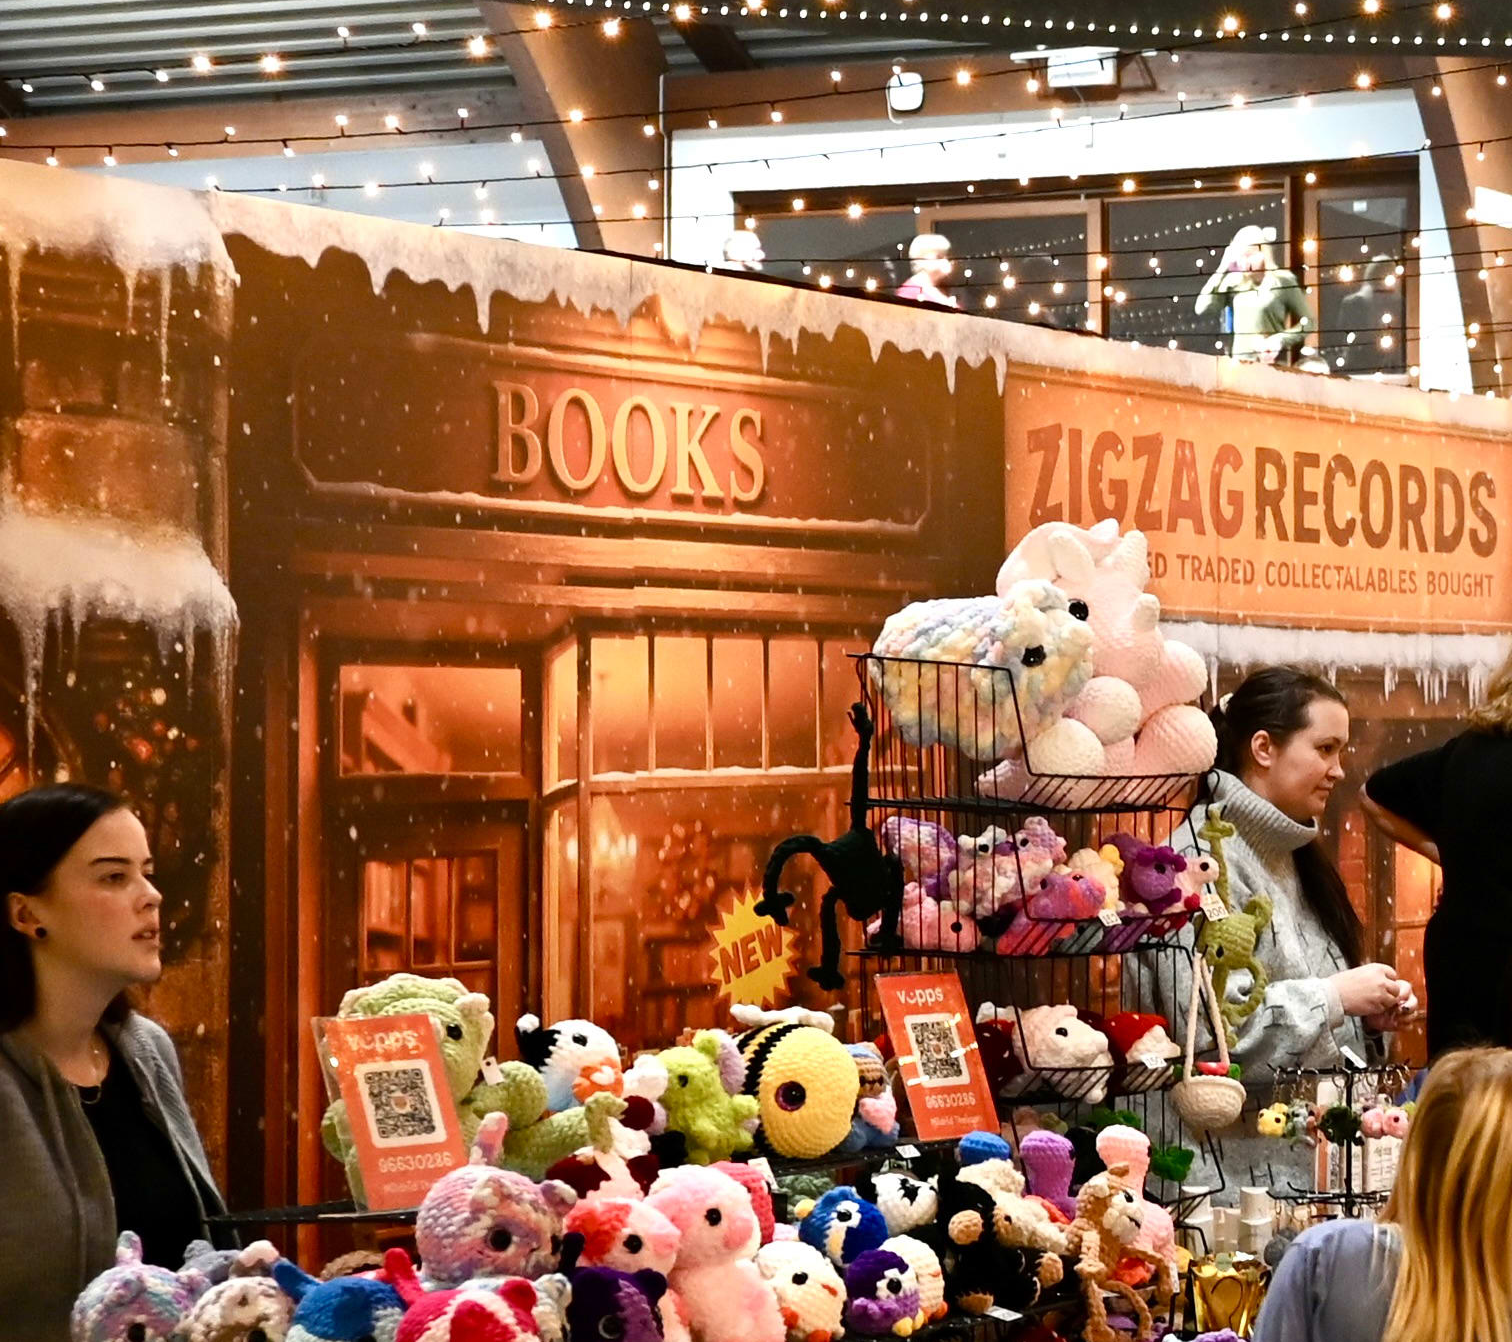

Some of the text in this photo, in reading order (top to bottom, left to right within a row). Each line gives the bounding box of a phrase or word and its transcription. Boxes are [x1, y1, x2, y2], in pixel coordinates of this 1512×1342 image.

[490, 380, 767, 505] BOOKS
[1027, 422, 1498, 558] ZIGZAG RECORDS
[1176, 553, 1255, 586] TRADED
[1264, 560, 1418, 596] COLLECTALABLES
[1426, 573, 1494, 598] BOUGHT
[719, 923, 783, 985] NEW
